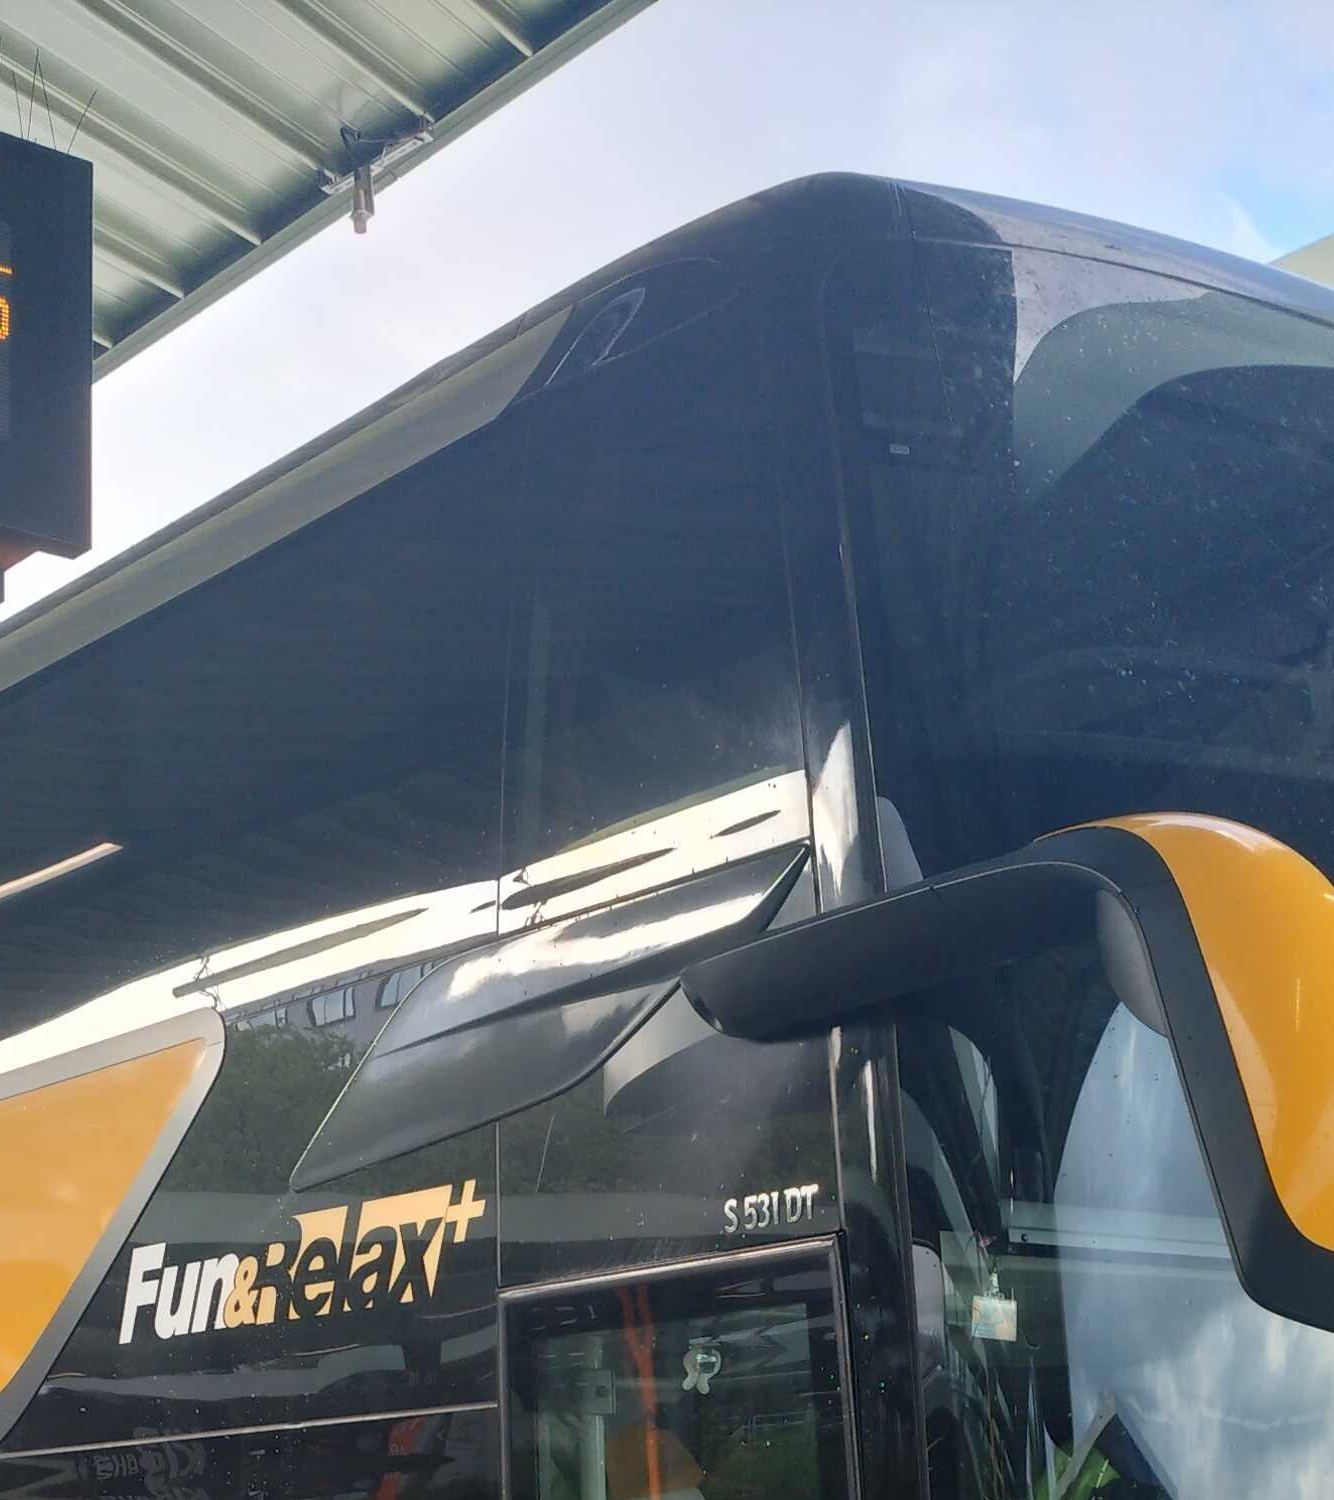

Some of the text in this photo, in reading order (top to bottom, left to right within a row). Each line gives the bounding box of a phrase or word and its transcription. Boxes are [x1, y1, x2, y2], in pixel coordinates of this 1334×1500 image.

[724, 1183, 820, 1233] S 531 DT
